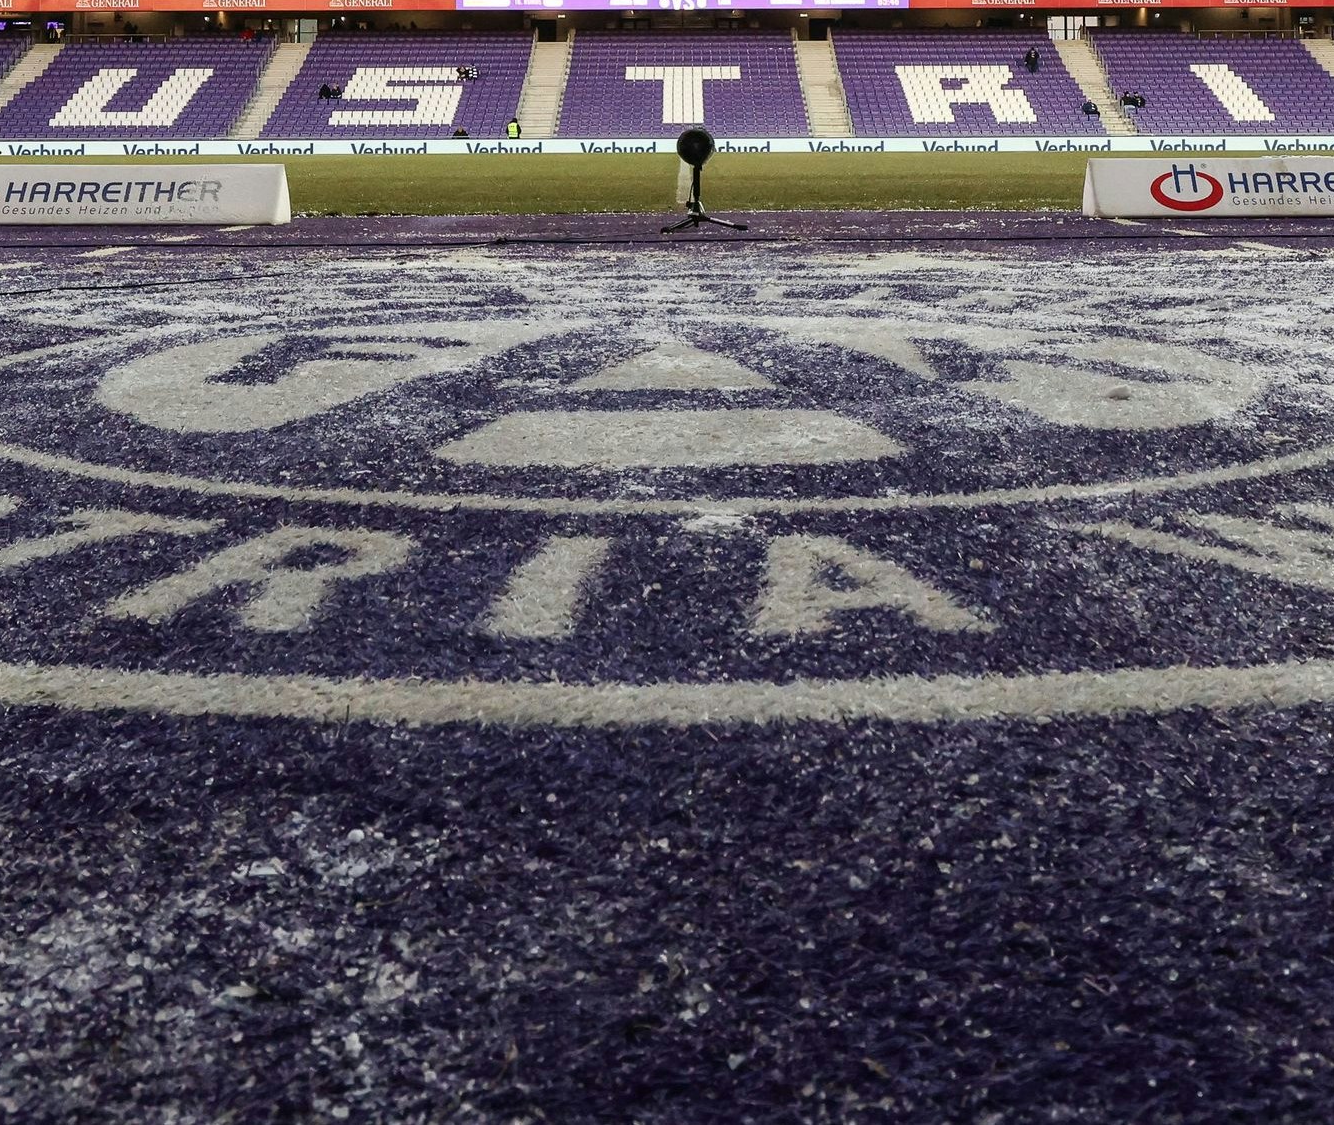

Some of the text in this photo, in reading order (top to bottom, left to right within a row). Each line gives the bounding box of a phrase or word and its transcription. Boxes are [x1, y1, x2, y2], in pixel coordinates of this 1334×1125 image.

[8, 144, 85, 156] Verbund
[122, 144, 200, 155] Verbund
[237, 143, 314, 155] Verbund
[350, 143, 427, 154] Verbund
[465, 142, 543, 153] Verbund
[580, 142, 657, 153] Verbund
[714, 142, 771, 152] rbund
[808, 141, 885, 152] Verbund
[922, 140, 999, 152] Verbund
[1034, 140, 1111, 151] Verbund
[1149, 139, 1226, 151] Verbund
[4, 181, 222, 203] HARREITHER
[1232, 195, 1301, 206] Gesundes
[1, 205, 72, 216] Gesundes
[78, 205, 128, 216] Heizen
